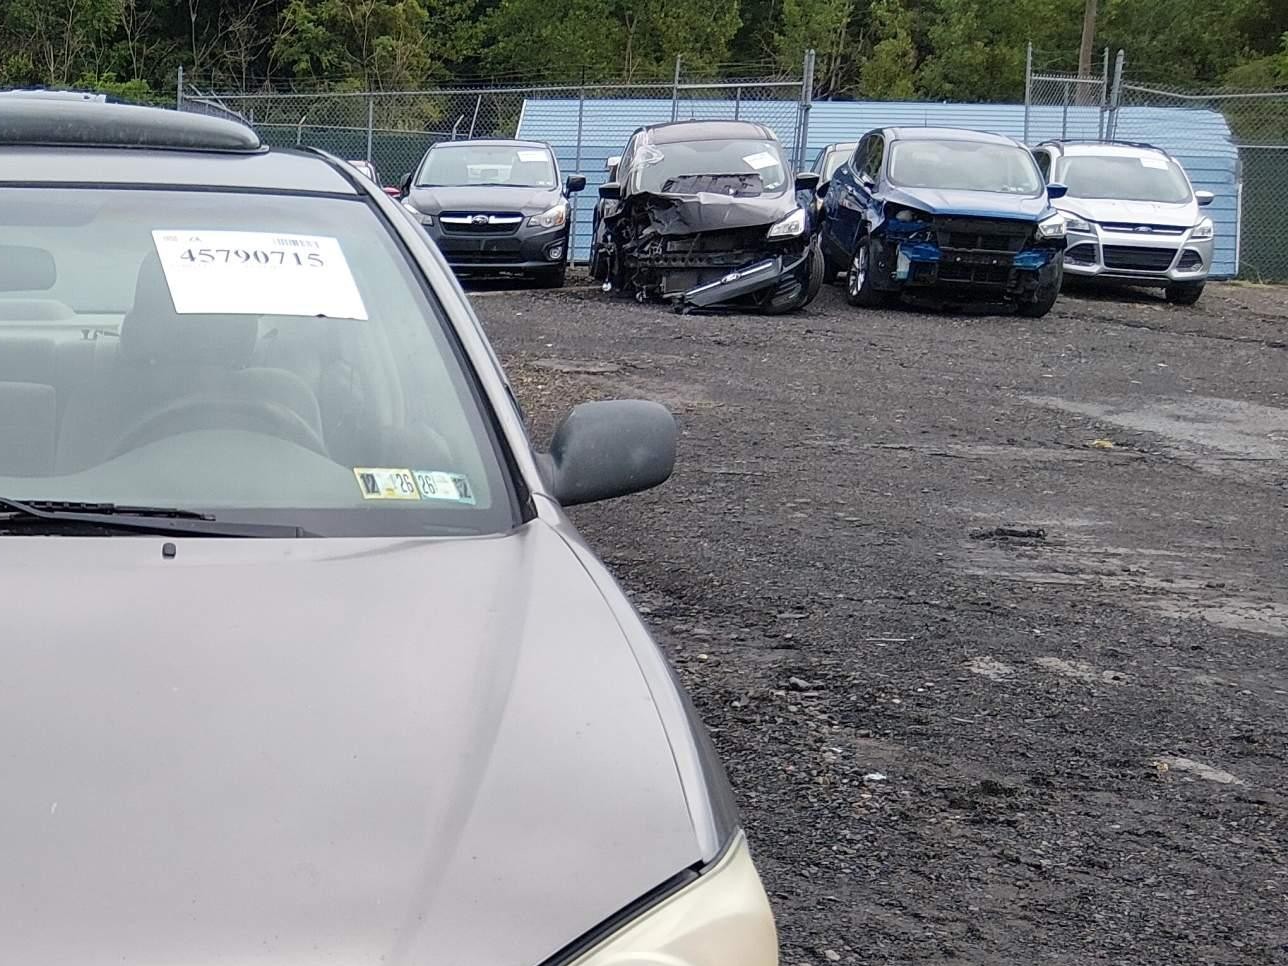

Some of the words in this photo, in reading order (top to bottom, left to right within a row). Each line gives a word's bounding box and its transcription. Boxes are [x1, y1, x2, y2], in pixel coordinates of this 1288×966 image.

[180, 248, 324, 267] 45790715
[396, 473, 415, 493] 26
[418, 474, 436, 494] 26
